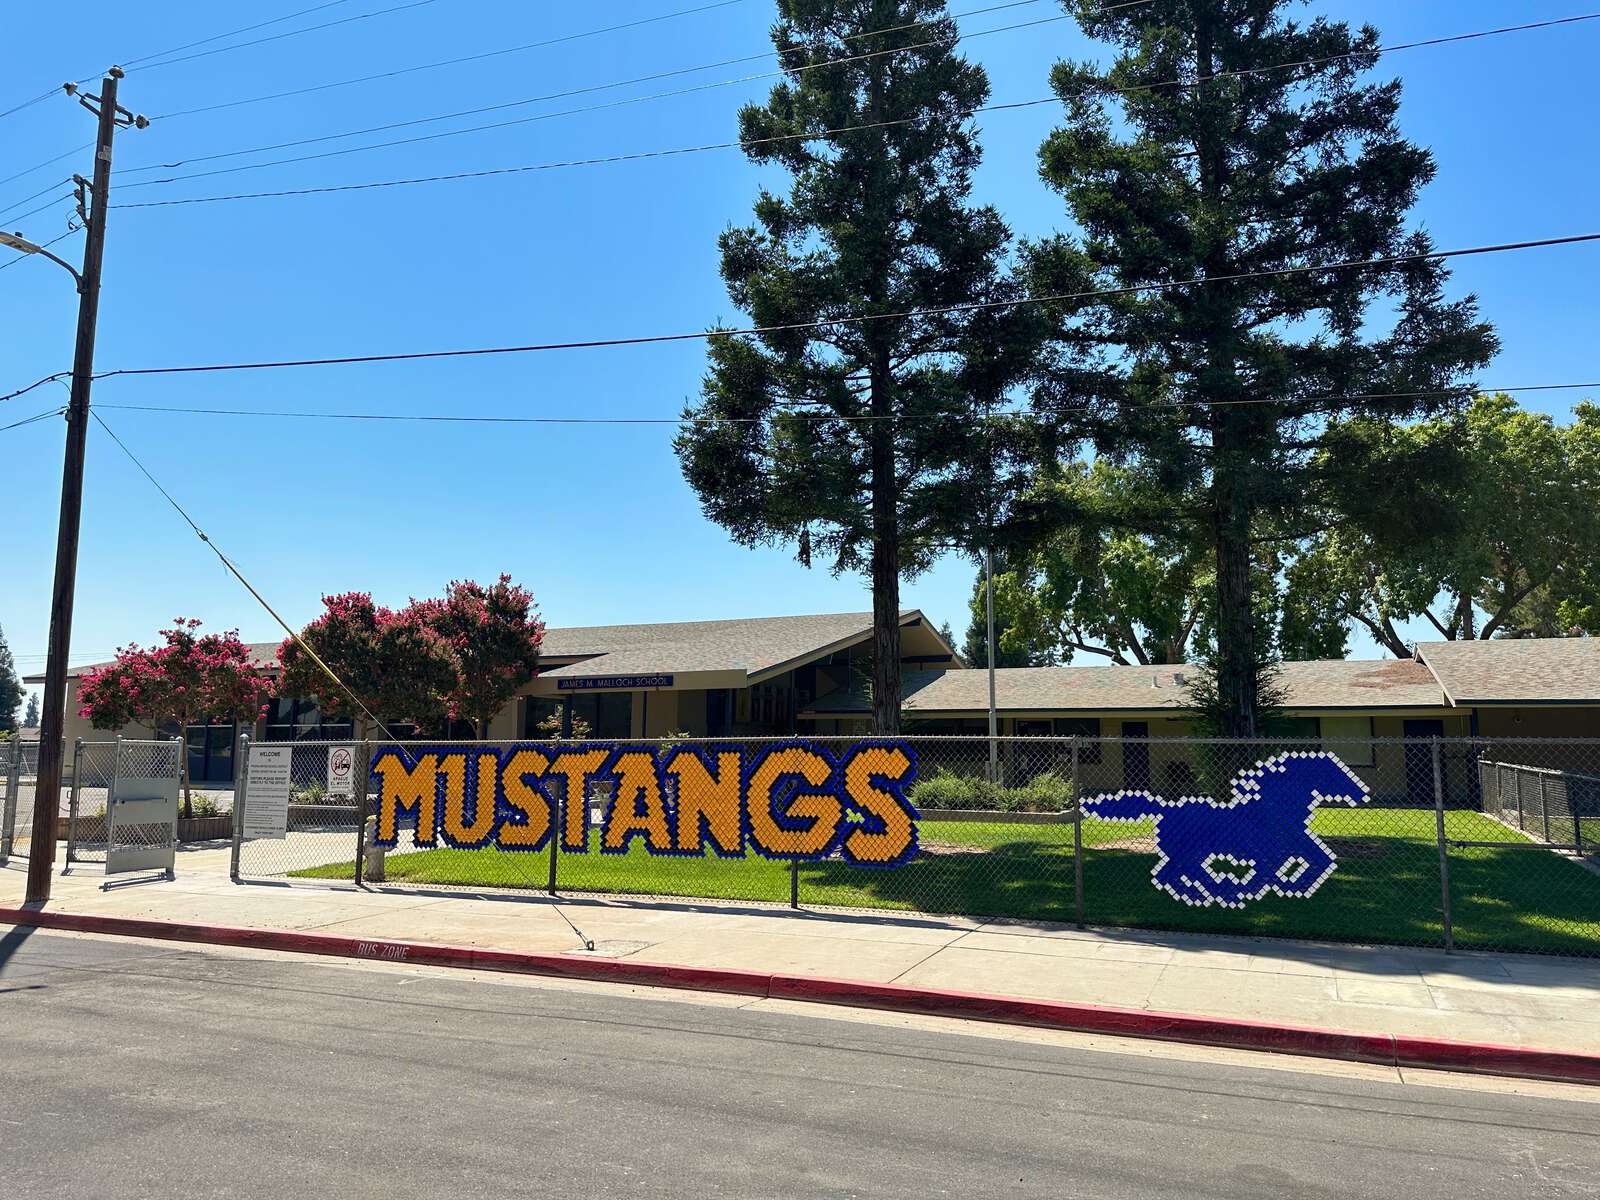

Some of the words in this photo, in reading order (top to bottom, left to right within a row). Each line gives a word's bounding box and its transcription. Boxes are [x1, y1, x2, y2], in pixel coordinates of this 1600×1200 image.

[561, 680, 584, 689] JAMES
[597, 678, 633, 688] MALLOCH
[636, 677, 667, 686] SCHOOL
[369, 741, 919, 868] MUSTANGS
[357, 943, 378, 955] BUS
[381, 944, 410, 960] ZONE
